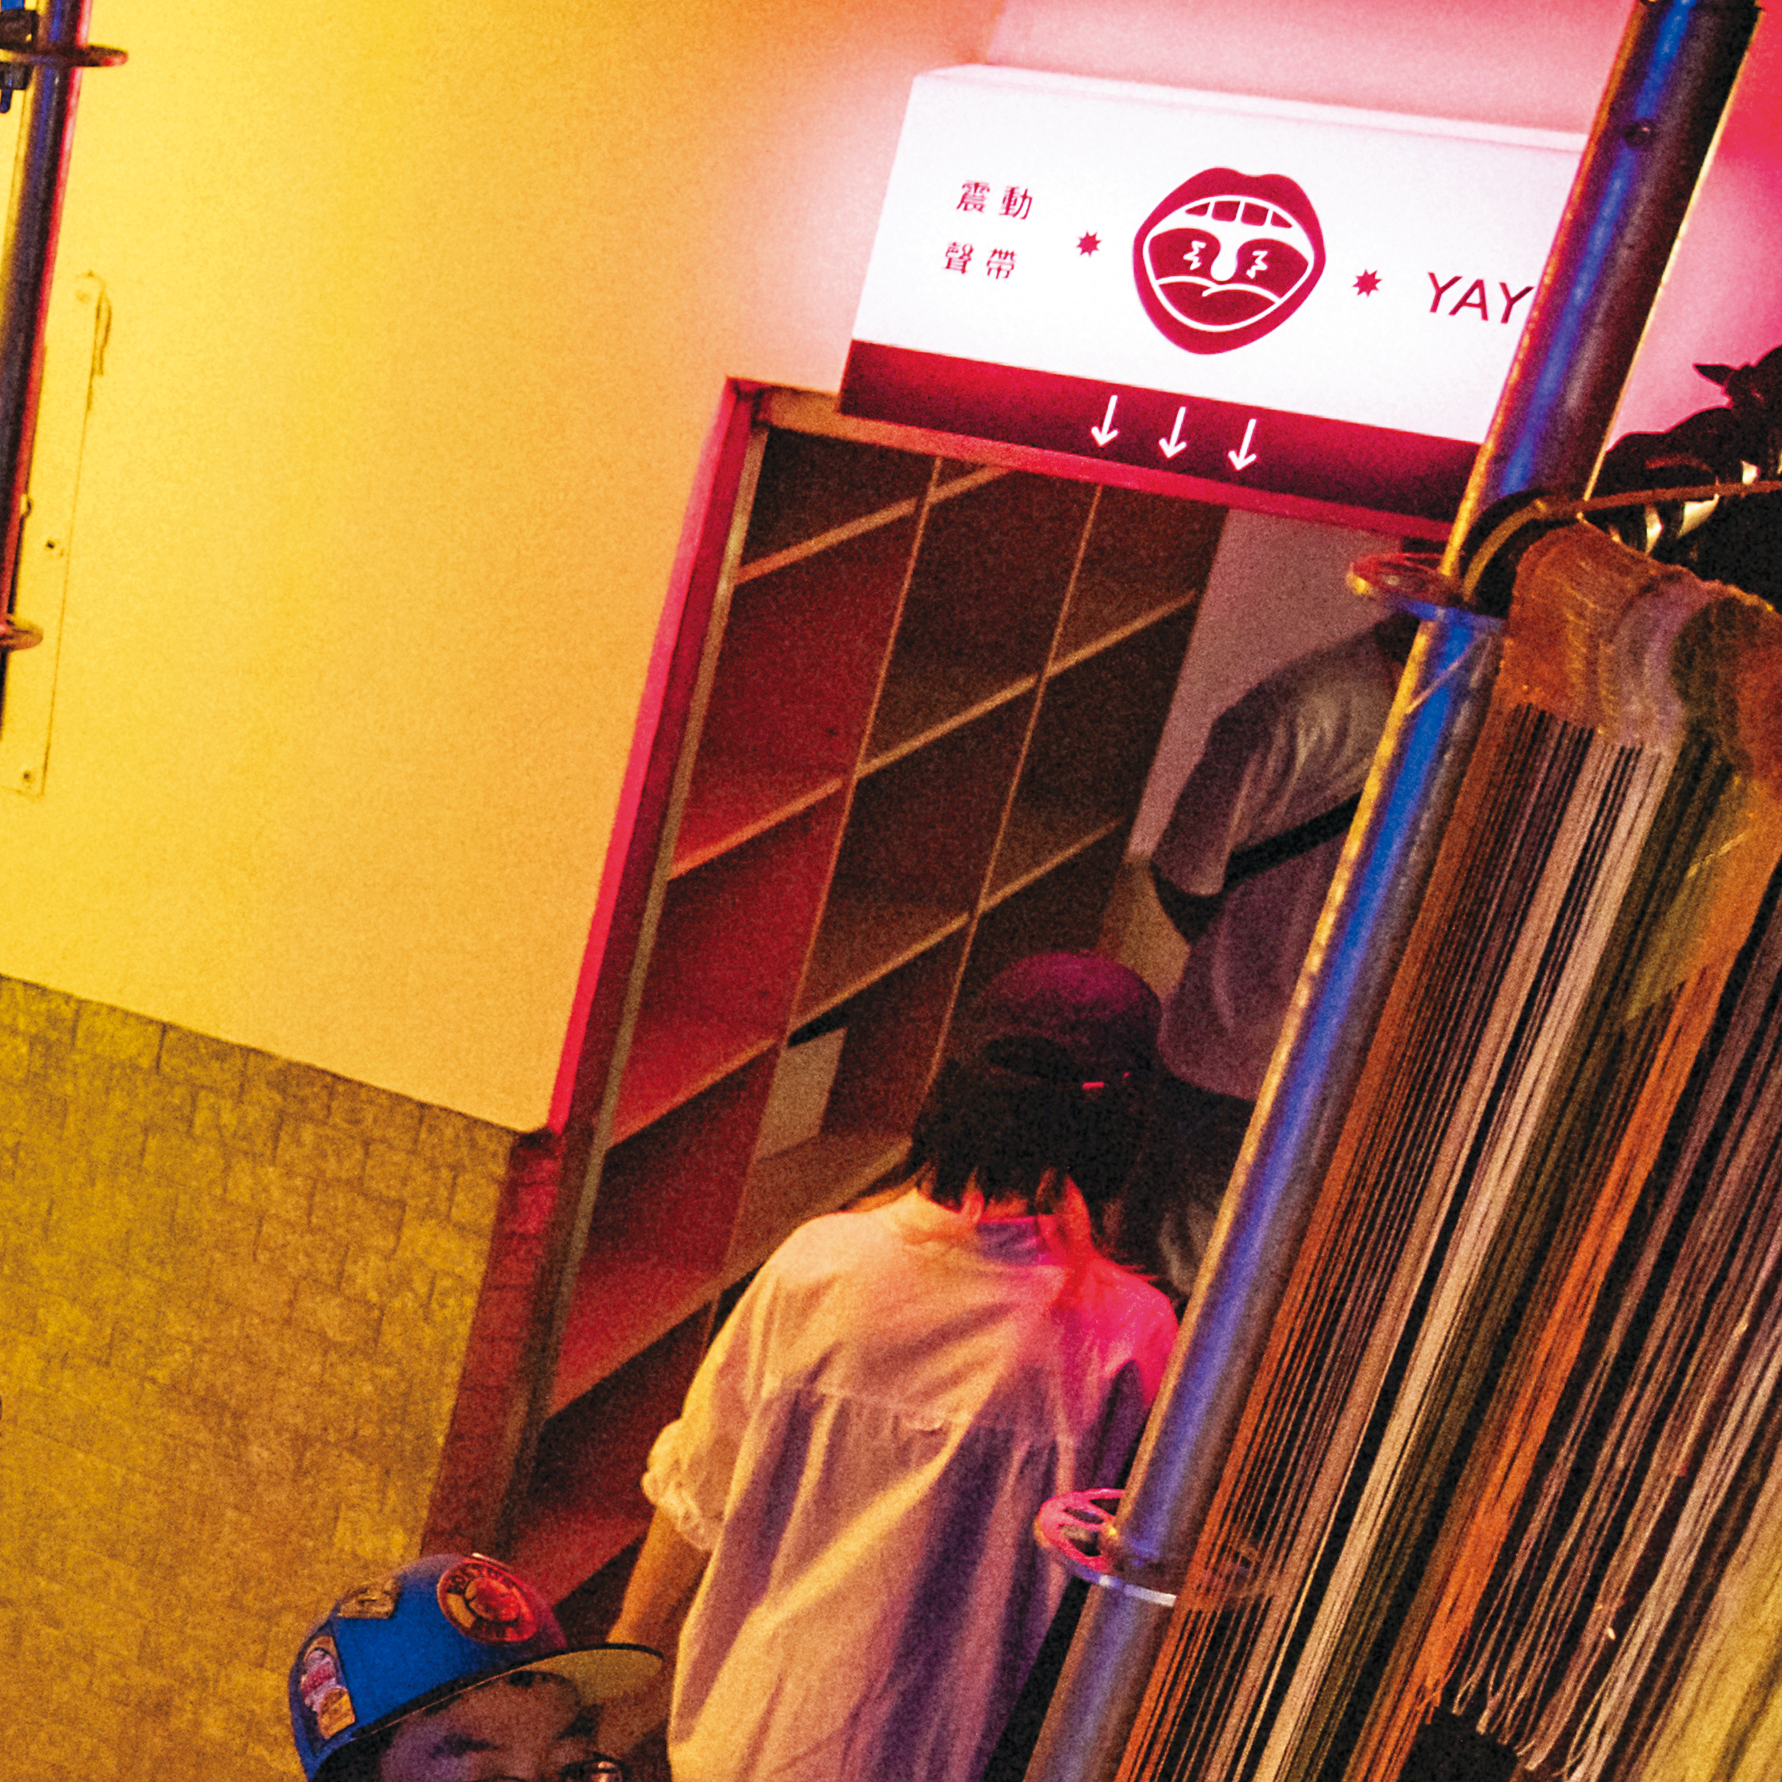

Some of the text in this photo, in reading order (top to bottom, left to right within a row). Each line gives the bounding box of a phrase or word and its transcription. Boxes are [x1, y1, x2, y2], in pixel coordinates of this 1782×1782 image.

[956, 179, 1033, 220] 震動
[942, 241, 1017, 280] 聲帶
[1427, 271, 1535, 325] YAY
